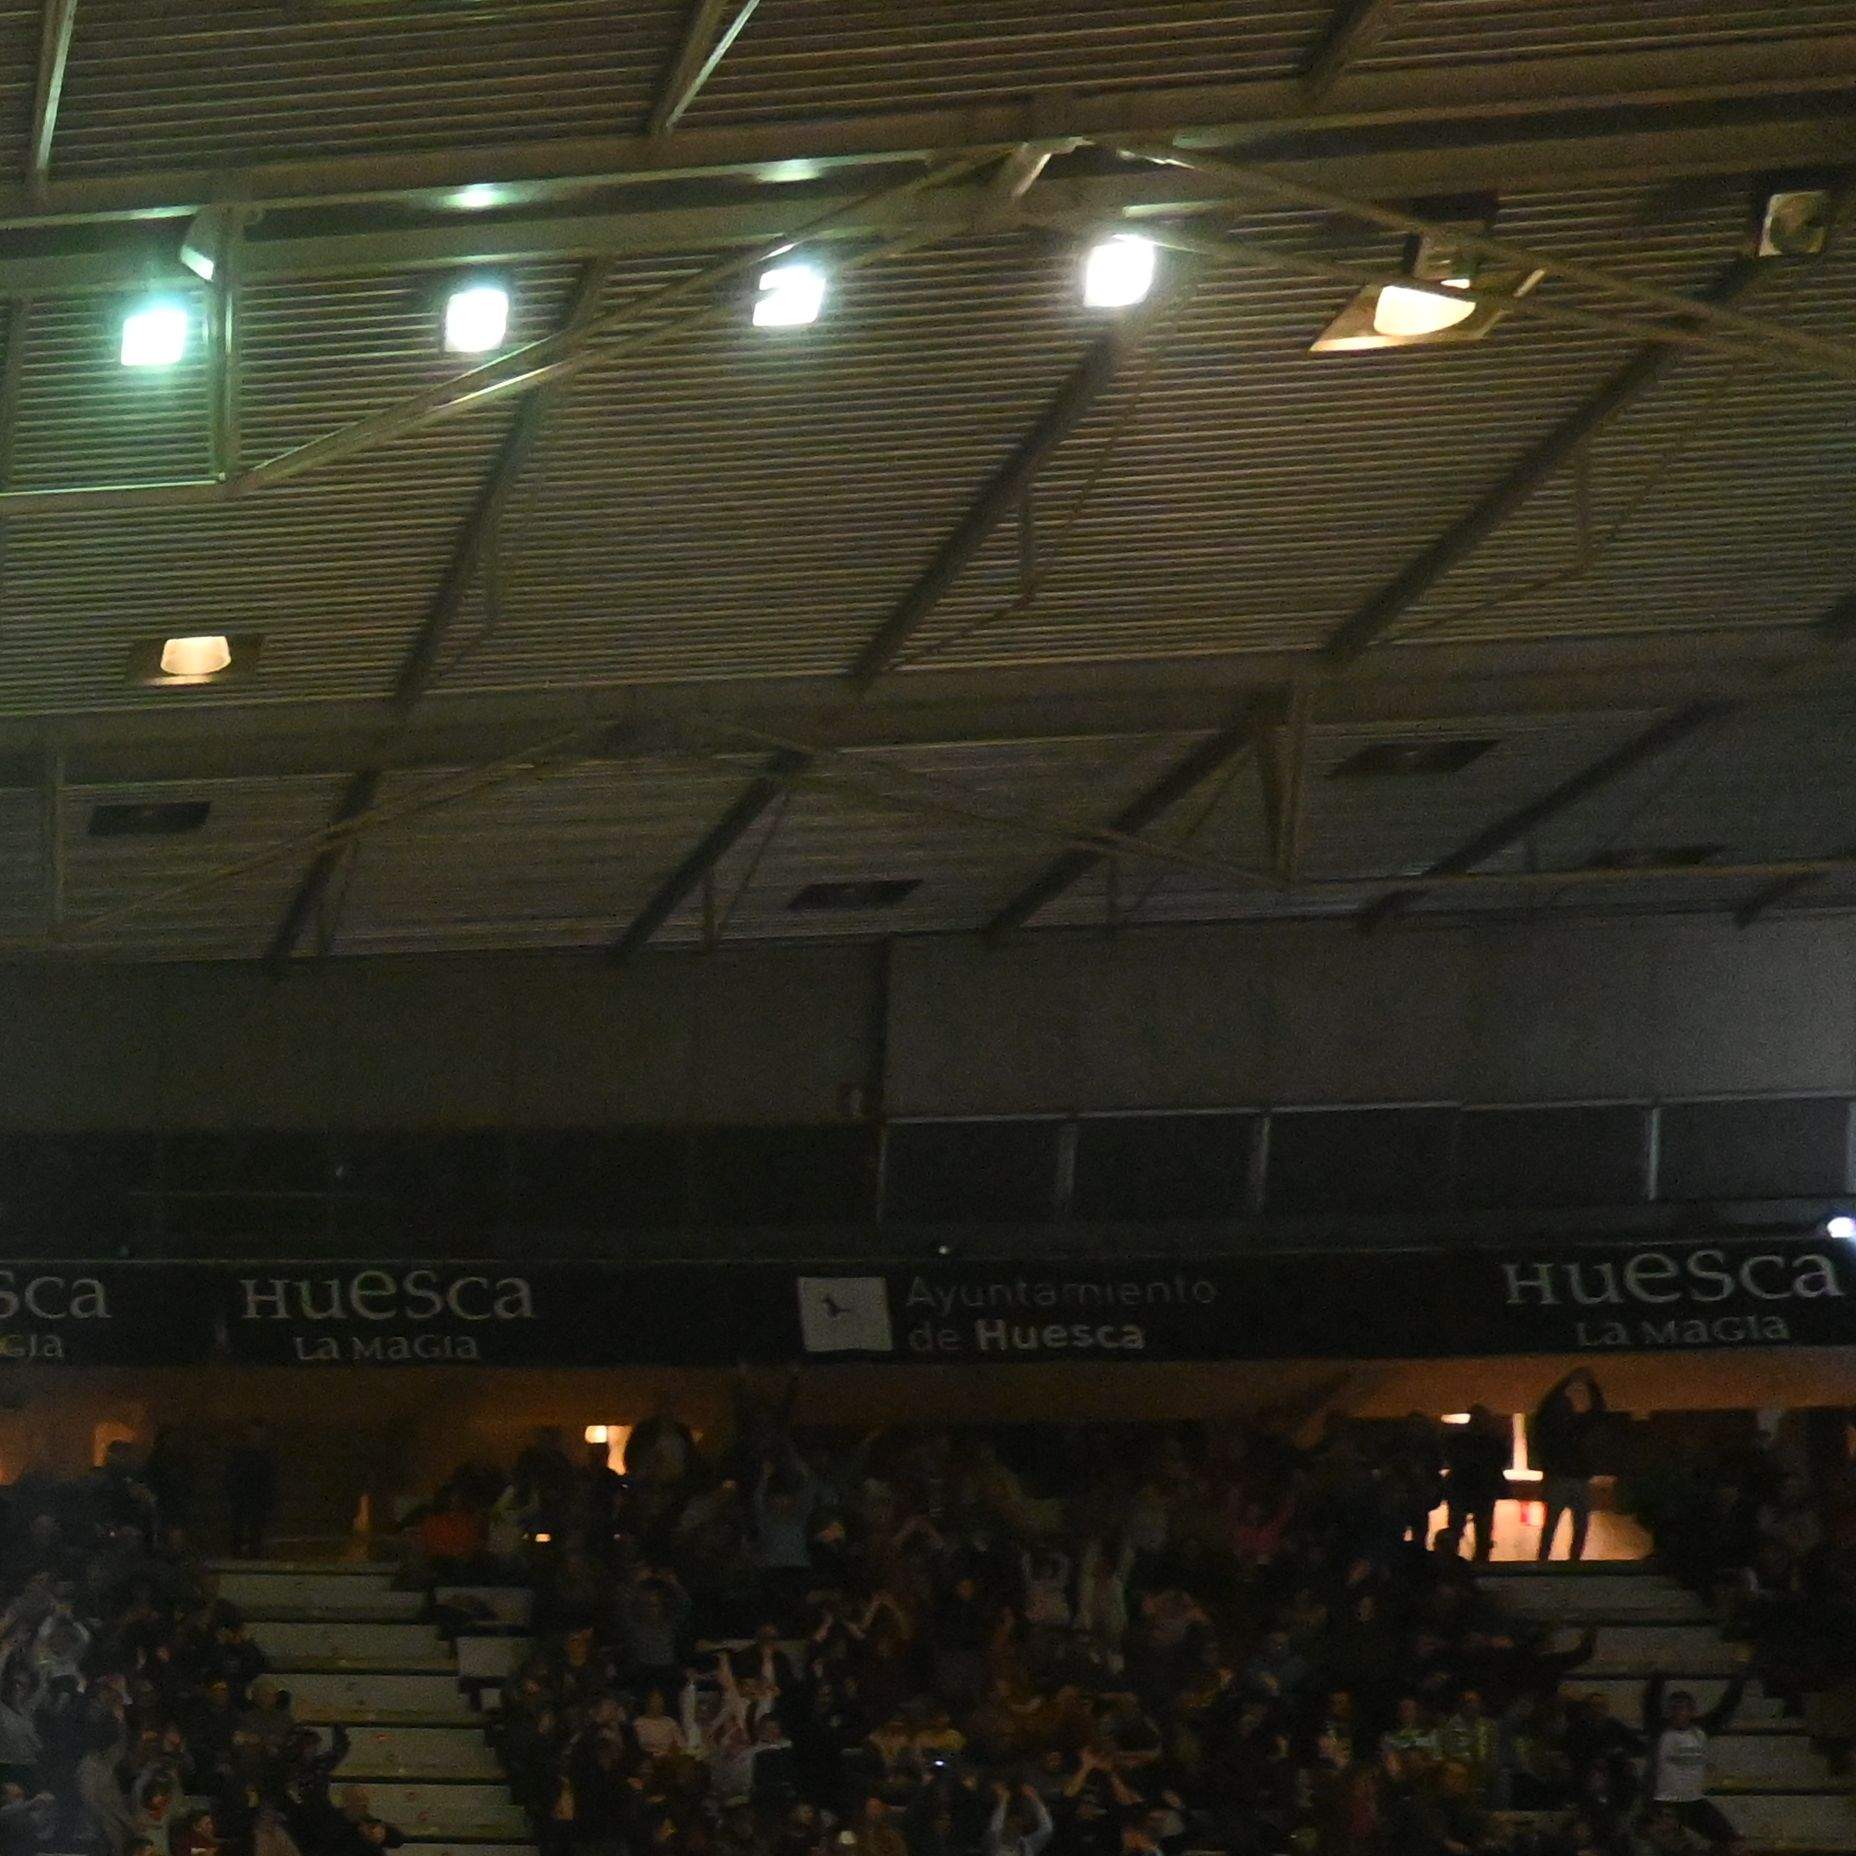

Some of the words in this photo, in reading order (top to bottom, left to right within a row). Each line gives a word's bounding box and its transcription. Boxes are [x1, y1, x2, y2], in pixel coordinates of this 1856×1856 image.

[907, 1276, 1219, 1315] Ayuntamiento
[908, 1324, 960, 1352] de
[975, 1318, 1146, 1352] Huesca
